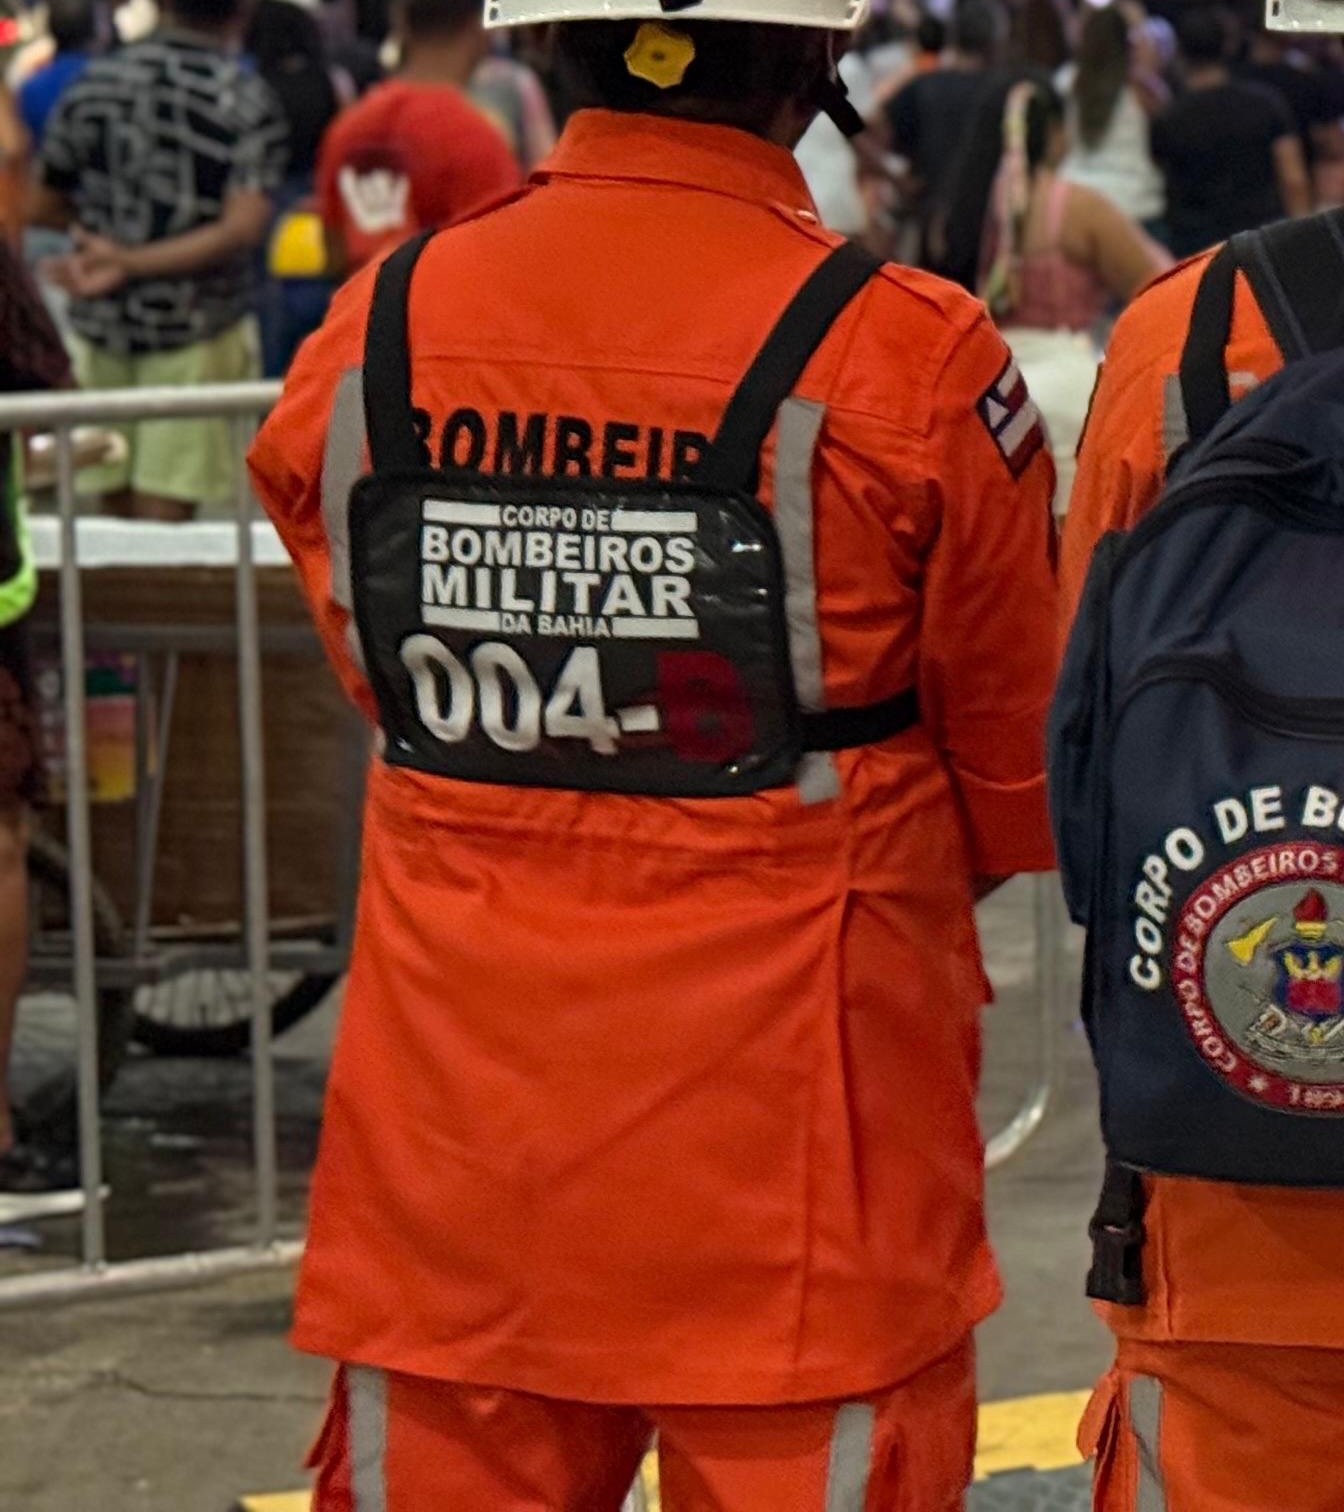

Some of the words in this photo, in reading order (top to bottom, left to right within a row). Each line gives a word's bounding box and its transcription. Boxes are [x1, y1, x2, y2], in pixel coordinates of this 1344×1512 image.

[501, 503, 577, 530] CORPO
[581, 506, 611, 532] DE
[421, 525, 696, 575] BOMBEIROS
[421, 562, 694, 618] MILITAR
[501, 615, 531, 636] DA
[537, 616, 612, 639] BAHIA
[1128, 826, 1205, 990] CORPO
[1213, 785, 1287, 844] DE
[1183, 849, 1339, 938] BOMBEIROS
